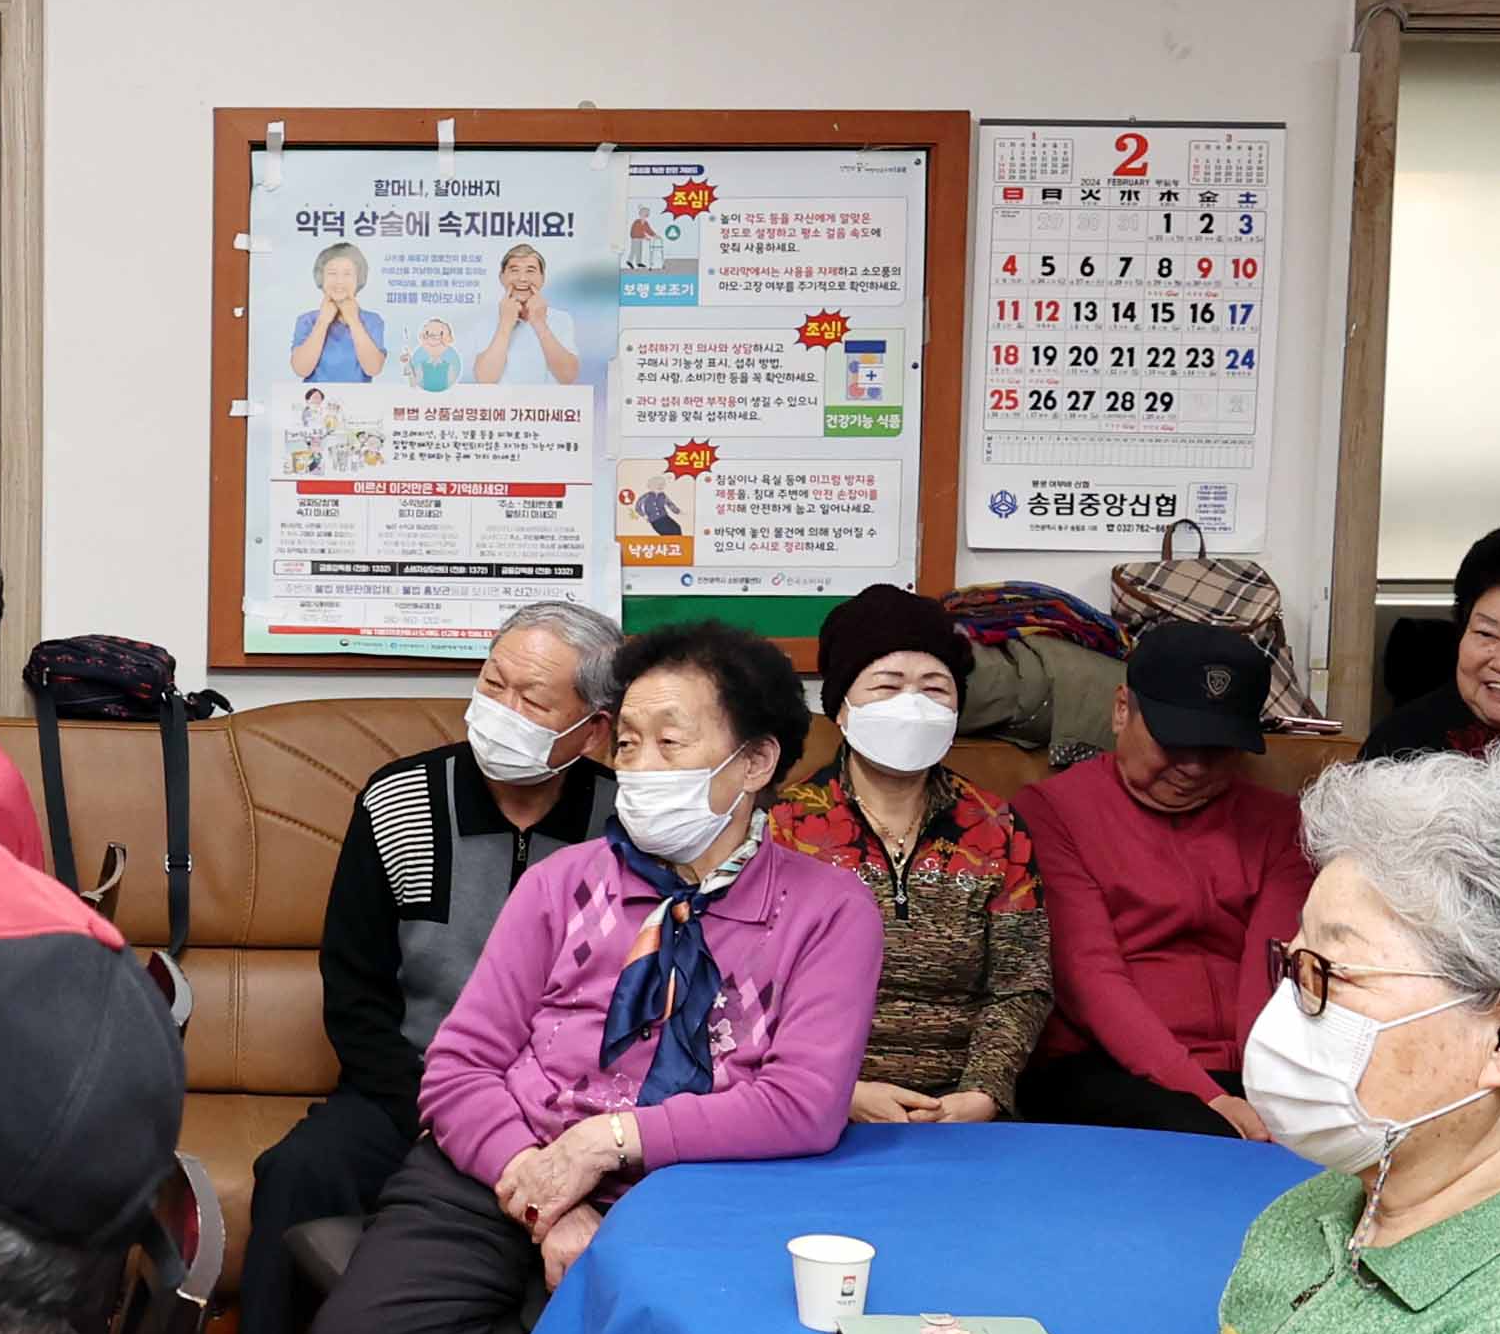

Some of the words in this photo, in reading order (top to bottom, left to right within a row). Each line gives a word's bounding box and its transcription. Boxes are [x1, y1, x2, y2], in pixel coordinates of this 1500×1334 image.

[1113, 133, 1149, 177] 2
[374, 180, 429, 198] 할머니,
[434, 180, 500, 198] 할아버지
[1107, 179, 1149, 187] FEBRUARY
[672, 191, 709, 209] 조심!
[1003, 187, 1023, 200] 日
[1042, 189, 1062, 200] 月
[1081, 190, 1100, 201] 火
[1120, 190, 1139, 201] 水
[1159, 191, 1179, 202] 木
[1198, 191, 1219, 203] 金
[1238, 193, 1257, 203] 土
[296, 211, 345, 236] 악덕
[354, 211, 429, 237] 상술에
[439, 211, 574, 237] 속지마세요!
[745, 213, 766, 224] 각도
[770, 213, 789, 224] 등을
[794, 213, 836, 224] 자신에게
[840, 213, 872, 224] 알맞은
[1163, 213, 1171, 233] 1
[1199, 214, 1214, 233] 2
[1239, 214, 1253, 235] 3
[720, 227, 750, 238] 정도로
[754, 227, 797, 238] 설정하고
[801, 227, 822, 238] 평소
[826, 228, 846, 239] 걸음
[850, 228, 881, 239] 속도에
[720, 243, 740, 253] 맞춰
[744, 243, 800, 254] 사용하세요.
[720, 267, 779, 277] 내리막에서는
[784, 267, 813, 277] 사용을
[818, 267, 858, 278] 자제하고
[1002, 255, 1017, 275] 4
[1042, 256, 1055, 275] 5
[1080, 257, 1094, 276] 6
[1120, 257, 1133, 277] 7
[1158, 258, 1172, 277] 8
[1198, 258, 1212, 278] 9
[1232, 259, 1258, 279] 10
[624, 283, 650, 299] 보행
[654, 283, 694, 297] 보조기
[766, 281, 794, 293] 여부를
[798, 281, 846, 293] 주기적으로
[850, 281, 901, 293] 확인하세요.
[998, 301, 1020, 321] 11
[1035, 301, 1060, 321] 12
[1074, 302, 1098, 322] 13
[1112, 303, 1136, 322] 14
[1152, 303, 1174, 323] 15
[1190, 303, 1214, 323] 16
[1228, 305, 1254, 325] 17
[805, 321, 841, 339] 조심!
[638, 343, 680, 354] 섭취하기
[683, 344, 693, 354] 전
[696, 343, 728, 354] 의사와
[732, 343, 784, 354] 상담하시고
[993, 345, 1019, 365] 18
[1032, 346, 1057, 366] 19
[1068, 347, 1098, 366] 20
[1110, 347, 1134, 367] 21
[1147, 347, 1176, 367] 22
[1186, 348, 1214, 367] 23
[1226, 349, 1255, 369] 24
[637, 358, 669, 368] 구매시
[672, 358, 704, 369] 기능성
[735, 358, 755, 369] 섭취
[637, 372, 657, 383] 주의
[686, 372, 726, 383] 소비기한
[729, 373, 748, 383] 등을
[752, 373, 762, 383] 꼭
[765, 373, 818, 383] 확인하세요.
[636, 396, 656, 407] 과다
[660, 396, 680, 407] 섭취
[683, 397, 703, 407] 하면
[707, 396, 748, 407] 부작용이
[751, 396, 771, 407] 생길
[774, 397, 783, 407] 수
[787, 397, 818, 407] 있으니
[990, 389, 1018, 410] 25
[1029, 391, 1057, 410] 26
[1068, 391, 1096, 411] 27
[1106, 391, 1134, 411] 28
[1145, 392, 1173, 412] 29
[393, 408, 419, 421] 불법
[425, 408, 505, 422] 상품설명회에
[511, 409, 581, 423] 가지마세요!
[682, 411, 703, 421] 맞춰
[707, 411, 761, 422] 섭취하세요.
[826, 414, 873, 429] 건강기능
[876, 414, 901, 429] 식품
[674, 451, 710, 468] 조심!
[716, 474, 758, 486] 침실이나
[762, 474, 782, 486] 욕실
[786, 475, 806, 485] 등에
[809, 475, 841, 486] 미끄럼
[844, 475, 875, 486] 방지용
[1074, 481, 1090, 489] 신협
[354, 483, 386, 494] 어르신
[390, 483, 432, 495] 이것만은
[436, 483, 448, 495] 꼭
[452, 483, 508, 496] 기억하세요!
[755, 489, 774, 500] 침대
[778, 489, 809, 500] 주변에
[812, 489, 833, 500] 안전
[837, 489, 877, 500] 손잡이를
[716, 503, 747, 514] 설치해
[750, 503, 792, 515] 안전하게
[795, 504, 816, 515] 눕고
[820, 504, 874, 515] 일어나세요.
[1028, 493, 1177, 517] 송림중앙신협
[714, 526, 746, 537] 바닥에
[749, 527, 770, 537] 놓인
[774, 527, 804, 538] 물건에
[808, 527, 829, 538] 의해
[832, 527, 863, 538] 넘어질
[867, 527, 877, 538] 수
[629, 543, 682, 557] 낙상사고
[714, 541, 746, 552] 있으니
[749, 541, 780, 552] 수시로
[784, 541, 838, 552] 정리하세요.
[502, 587, 512, 597] 꼭
